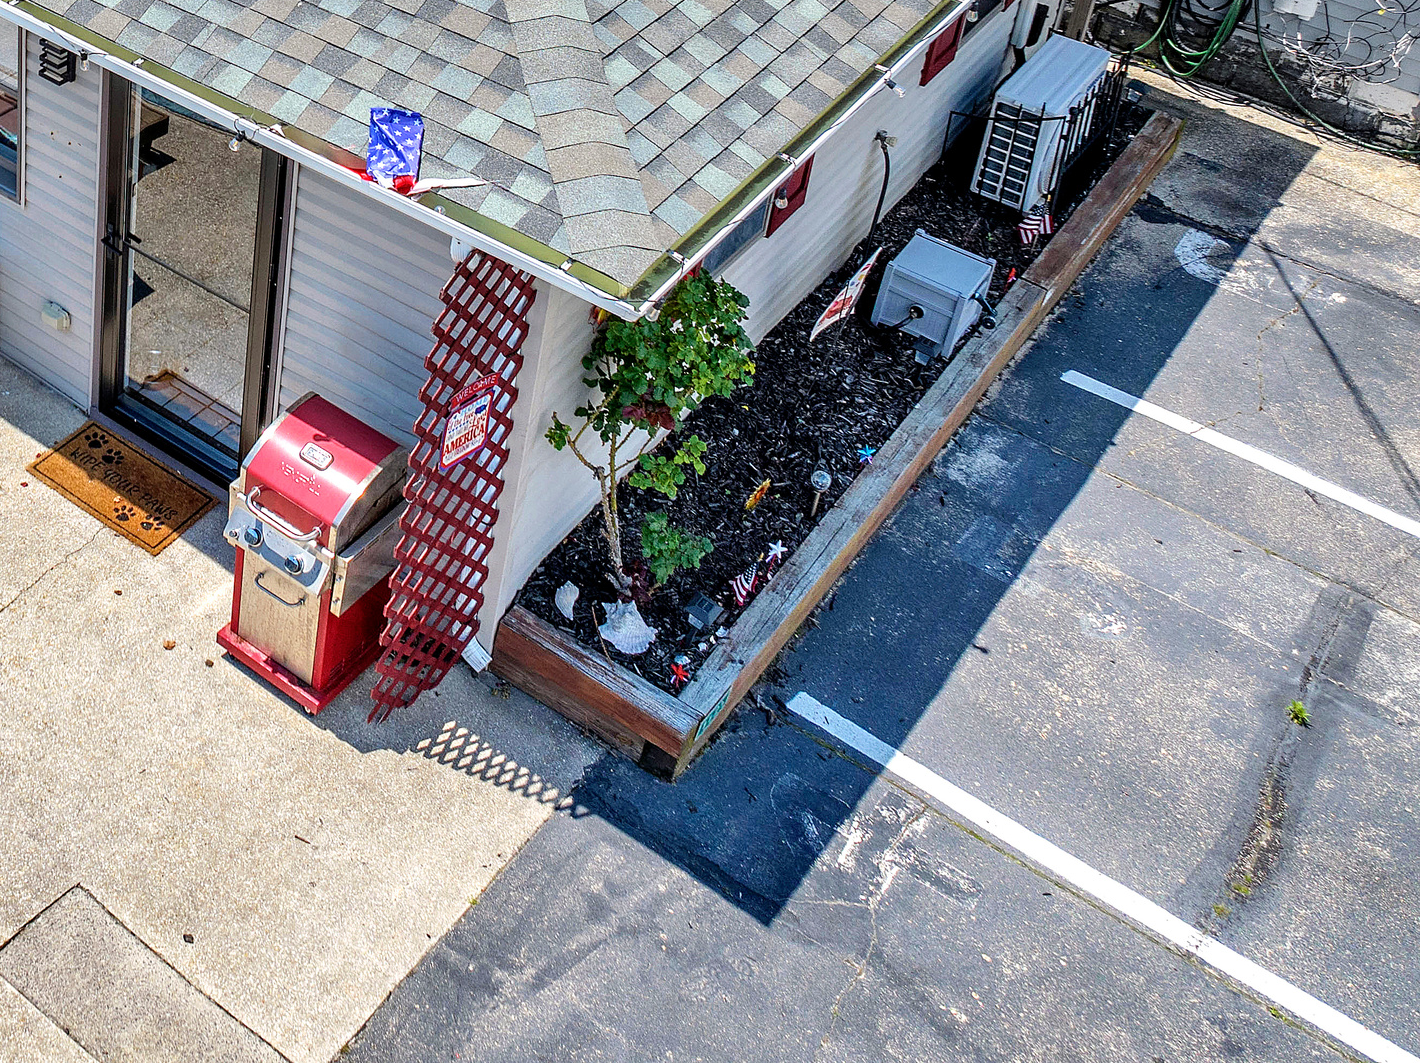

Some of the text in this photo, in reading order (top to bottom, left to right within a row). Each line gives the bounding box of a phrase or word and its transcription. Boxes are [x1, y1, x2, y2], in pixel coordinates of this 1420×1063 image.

[455, 374, 497, 402] WELCOME
[461, 396, 488, 416] HOME
[444, 424, 485, 454] AMERICA
[71, 447, 178, 520] WIPE YOUR PAWS
